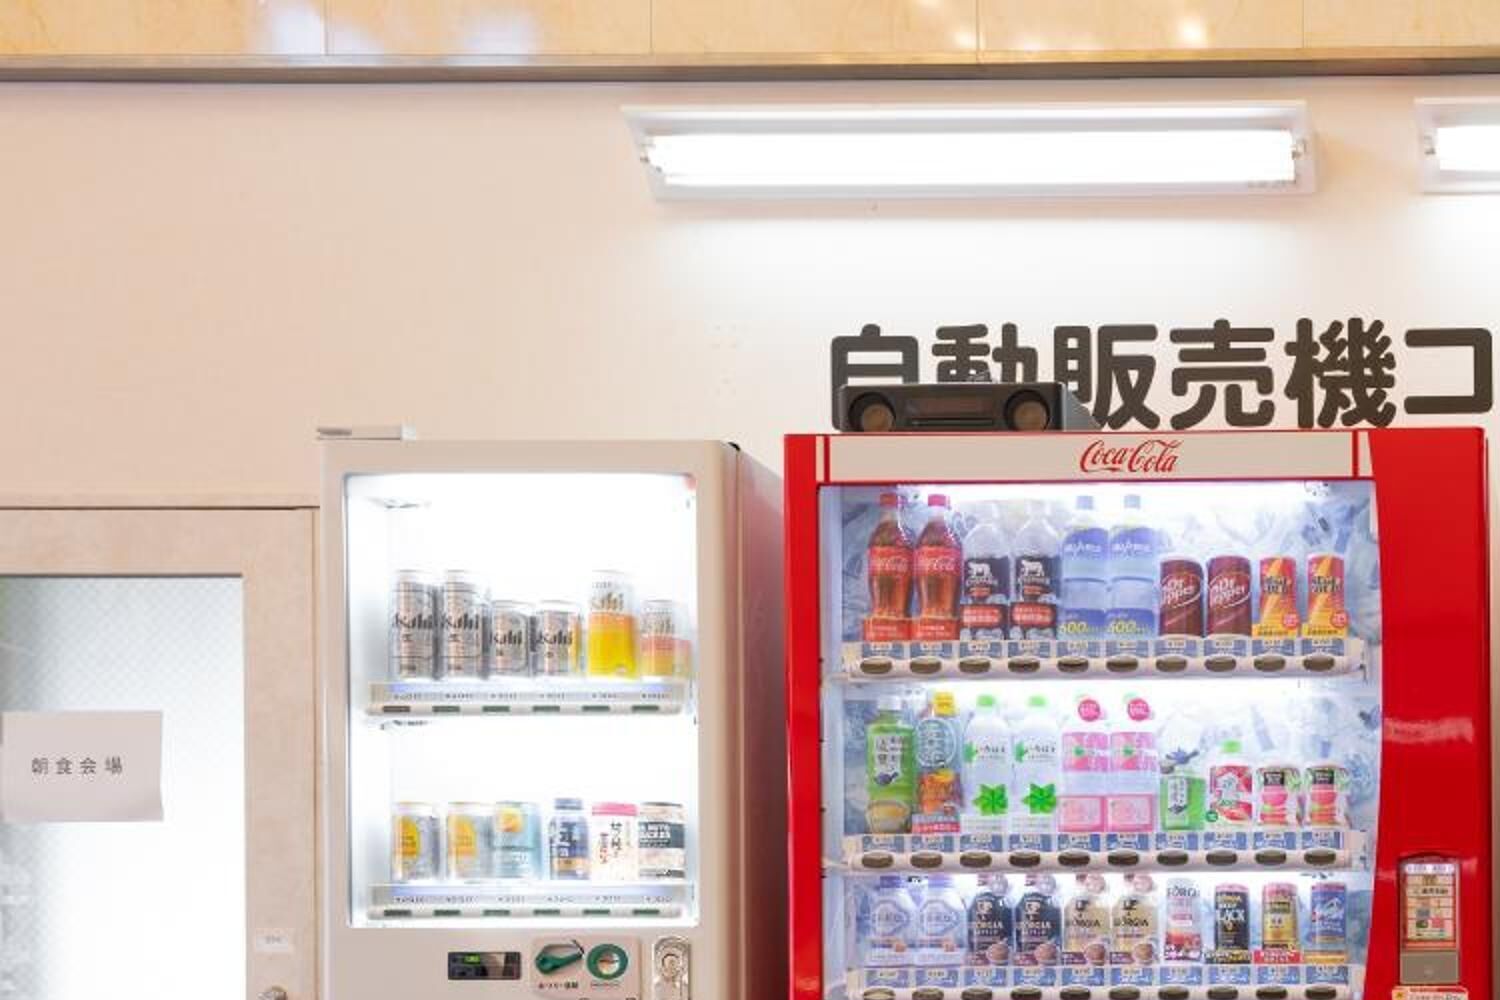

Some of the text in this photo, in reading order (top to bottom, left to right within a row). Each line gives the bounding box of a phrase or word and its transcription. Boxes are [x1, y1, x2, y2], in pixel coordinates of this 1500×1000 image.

[1080, 440, 1184, 473] Coca-Cola
[31, 757, 123, 775] 朝食会場
